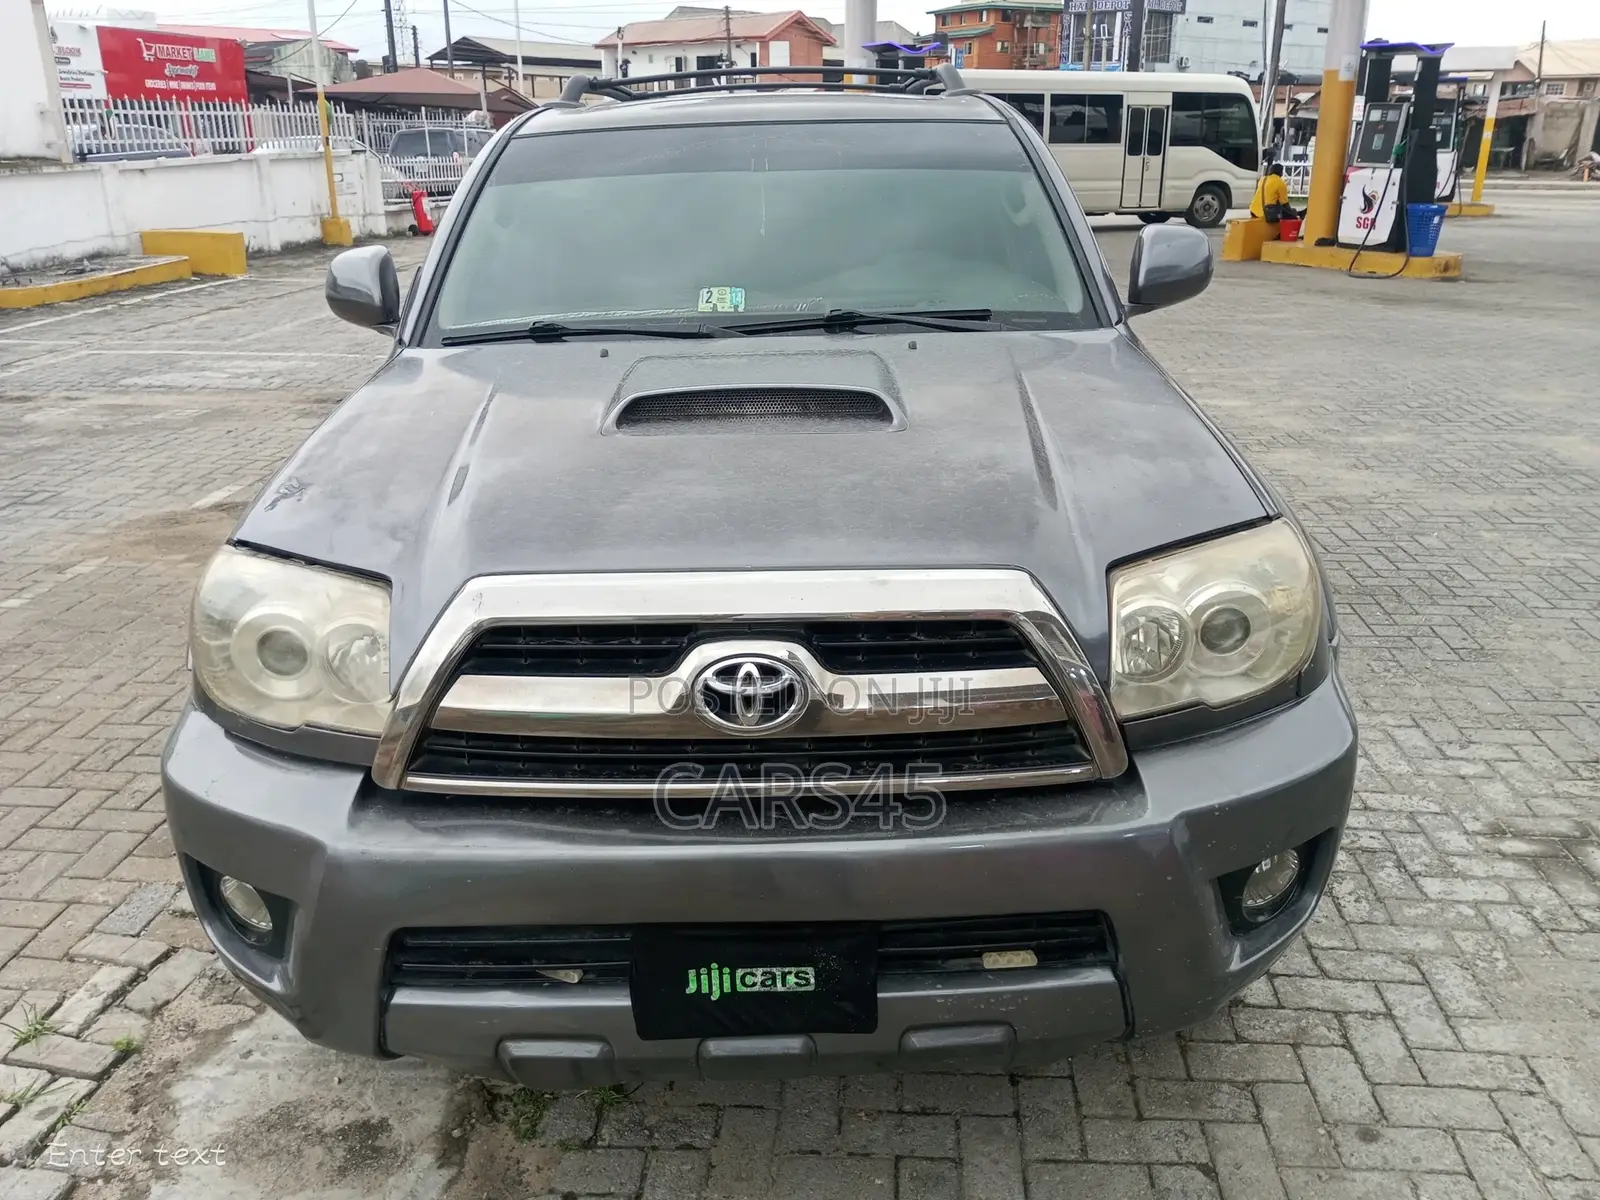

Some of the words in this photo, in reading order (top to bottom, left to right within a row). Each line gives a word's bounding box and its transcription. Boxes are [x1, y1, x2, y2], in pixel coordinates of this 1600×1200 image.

[1096, 0, 1130, 10] DEPOT
[157, 45, 192, 60] MARKET
[740, 969, 811, 989] cars
